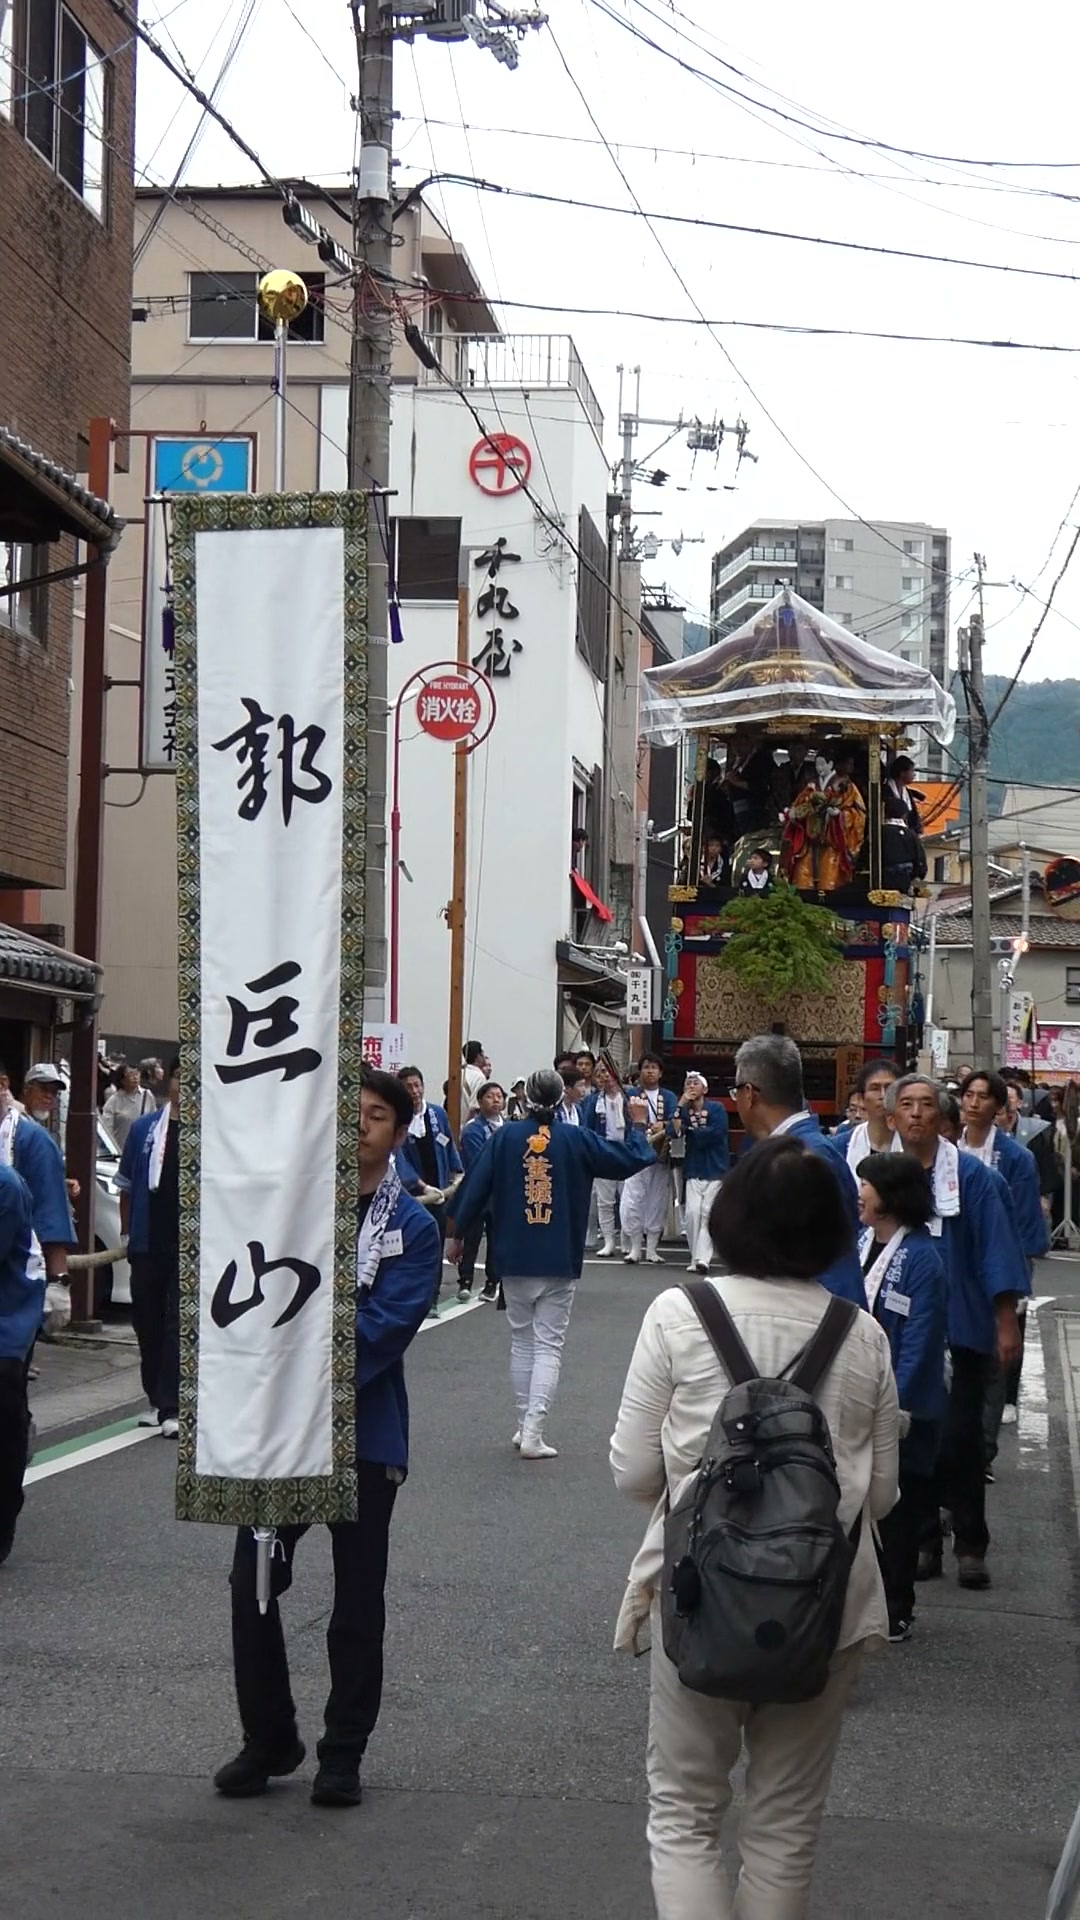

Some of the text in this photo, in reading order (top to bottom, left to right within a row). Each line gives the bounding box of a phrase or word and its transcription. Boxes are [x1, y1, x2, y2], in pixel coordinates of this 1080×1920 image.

[472, 537, 523, 678] 千丸屋
[421, 696, 477, 723] 消火栓
[211, 697, 332, 1328] 郭巨山
